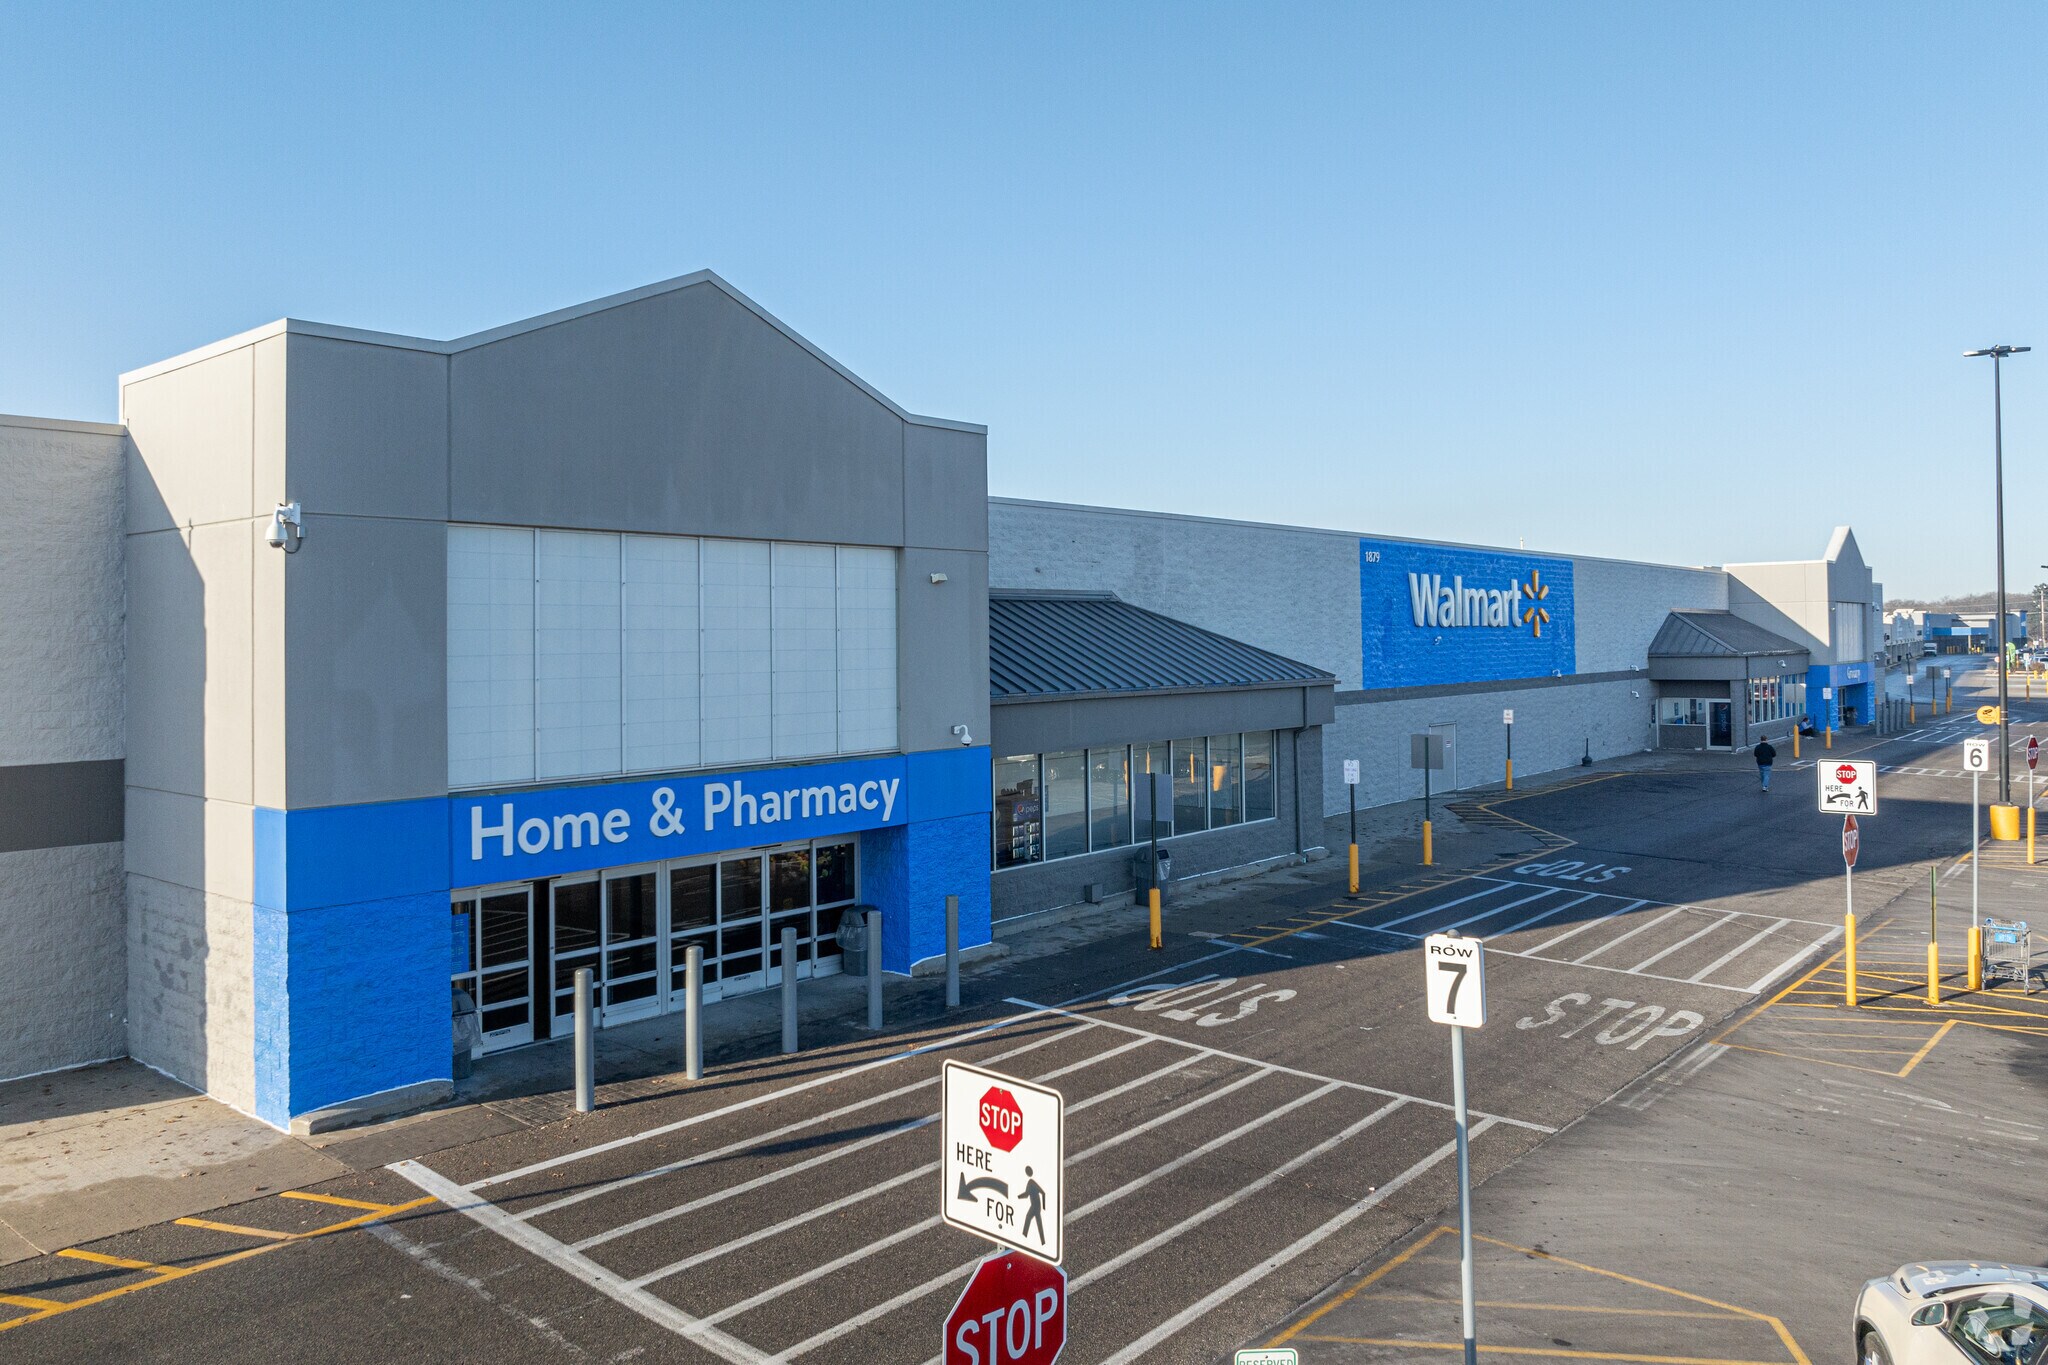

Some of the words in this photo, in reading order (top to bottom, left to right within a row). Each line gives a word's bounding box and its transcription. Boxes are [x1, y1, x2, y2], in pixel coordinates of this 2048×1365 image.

[1365, 551, 1380, 563] 1879
[1408, 572, 1522, 628] Walmart
[1970, 748, 1983, 768] 6
[2028, 747, 2039, 760] STOP
[1836, 770, 1857, 779] STOP
[1825, 785, 1843, 793] HERE
[1840, 800, 1854, 808] FOR
[470, 803, 631, 861] Home
[649, 787, 685, 838] &
[704, 778, 900, 832] Pharmacy
[1844, 829, 1858, 851] STOP
[1513, 860, 1632, 883] STOP
[1430, 945, 1473, 958] ROW
[1107, 974, 1298, 1027] STOP
[1438, 961, 1467, 1014] 7
[1515, 993, 1704, 1050] STOP
[980, 1102, 1022, 1135] STOP
[956, 1142, 993, 1172] HERE
[986, 1198, 1015, 1227] FOR
[956, 1287, 1058, 1365] STOP
